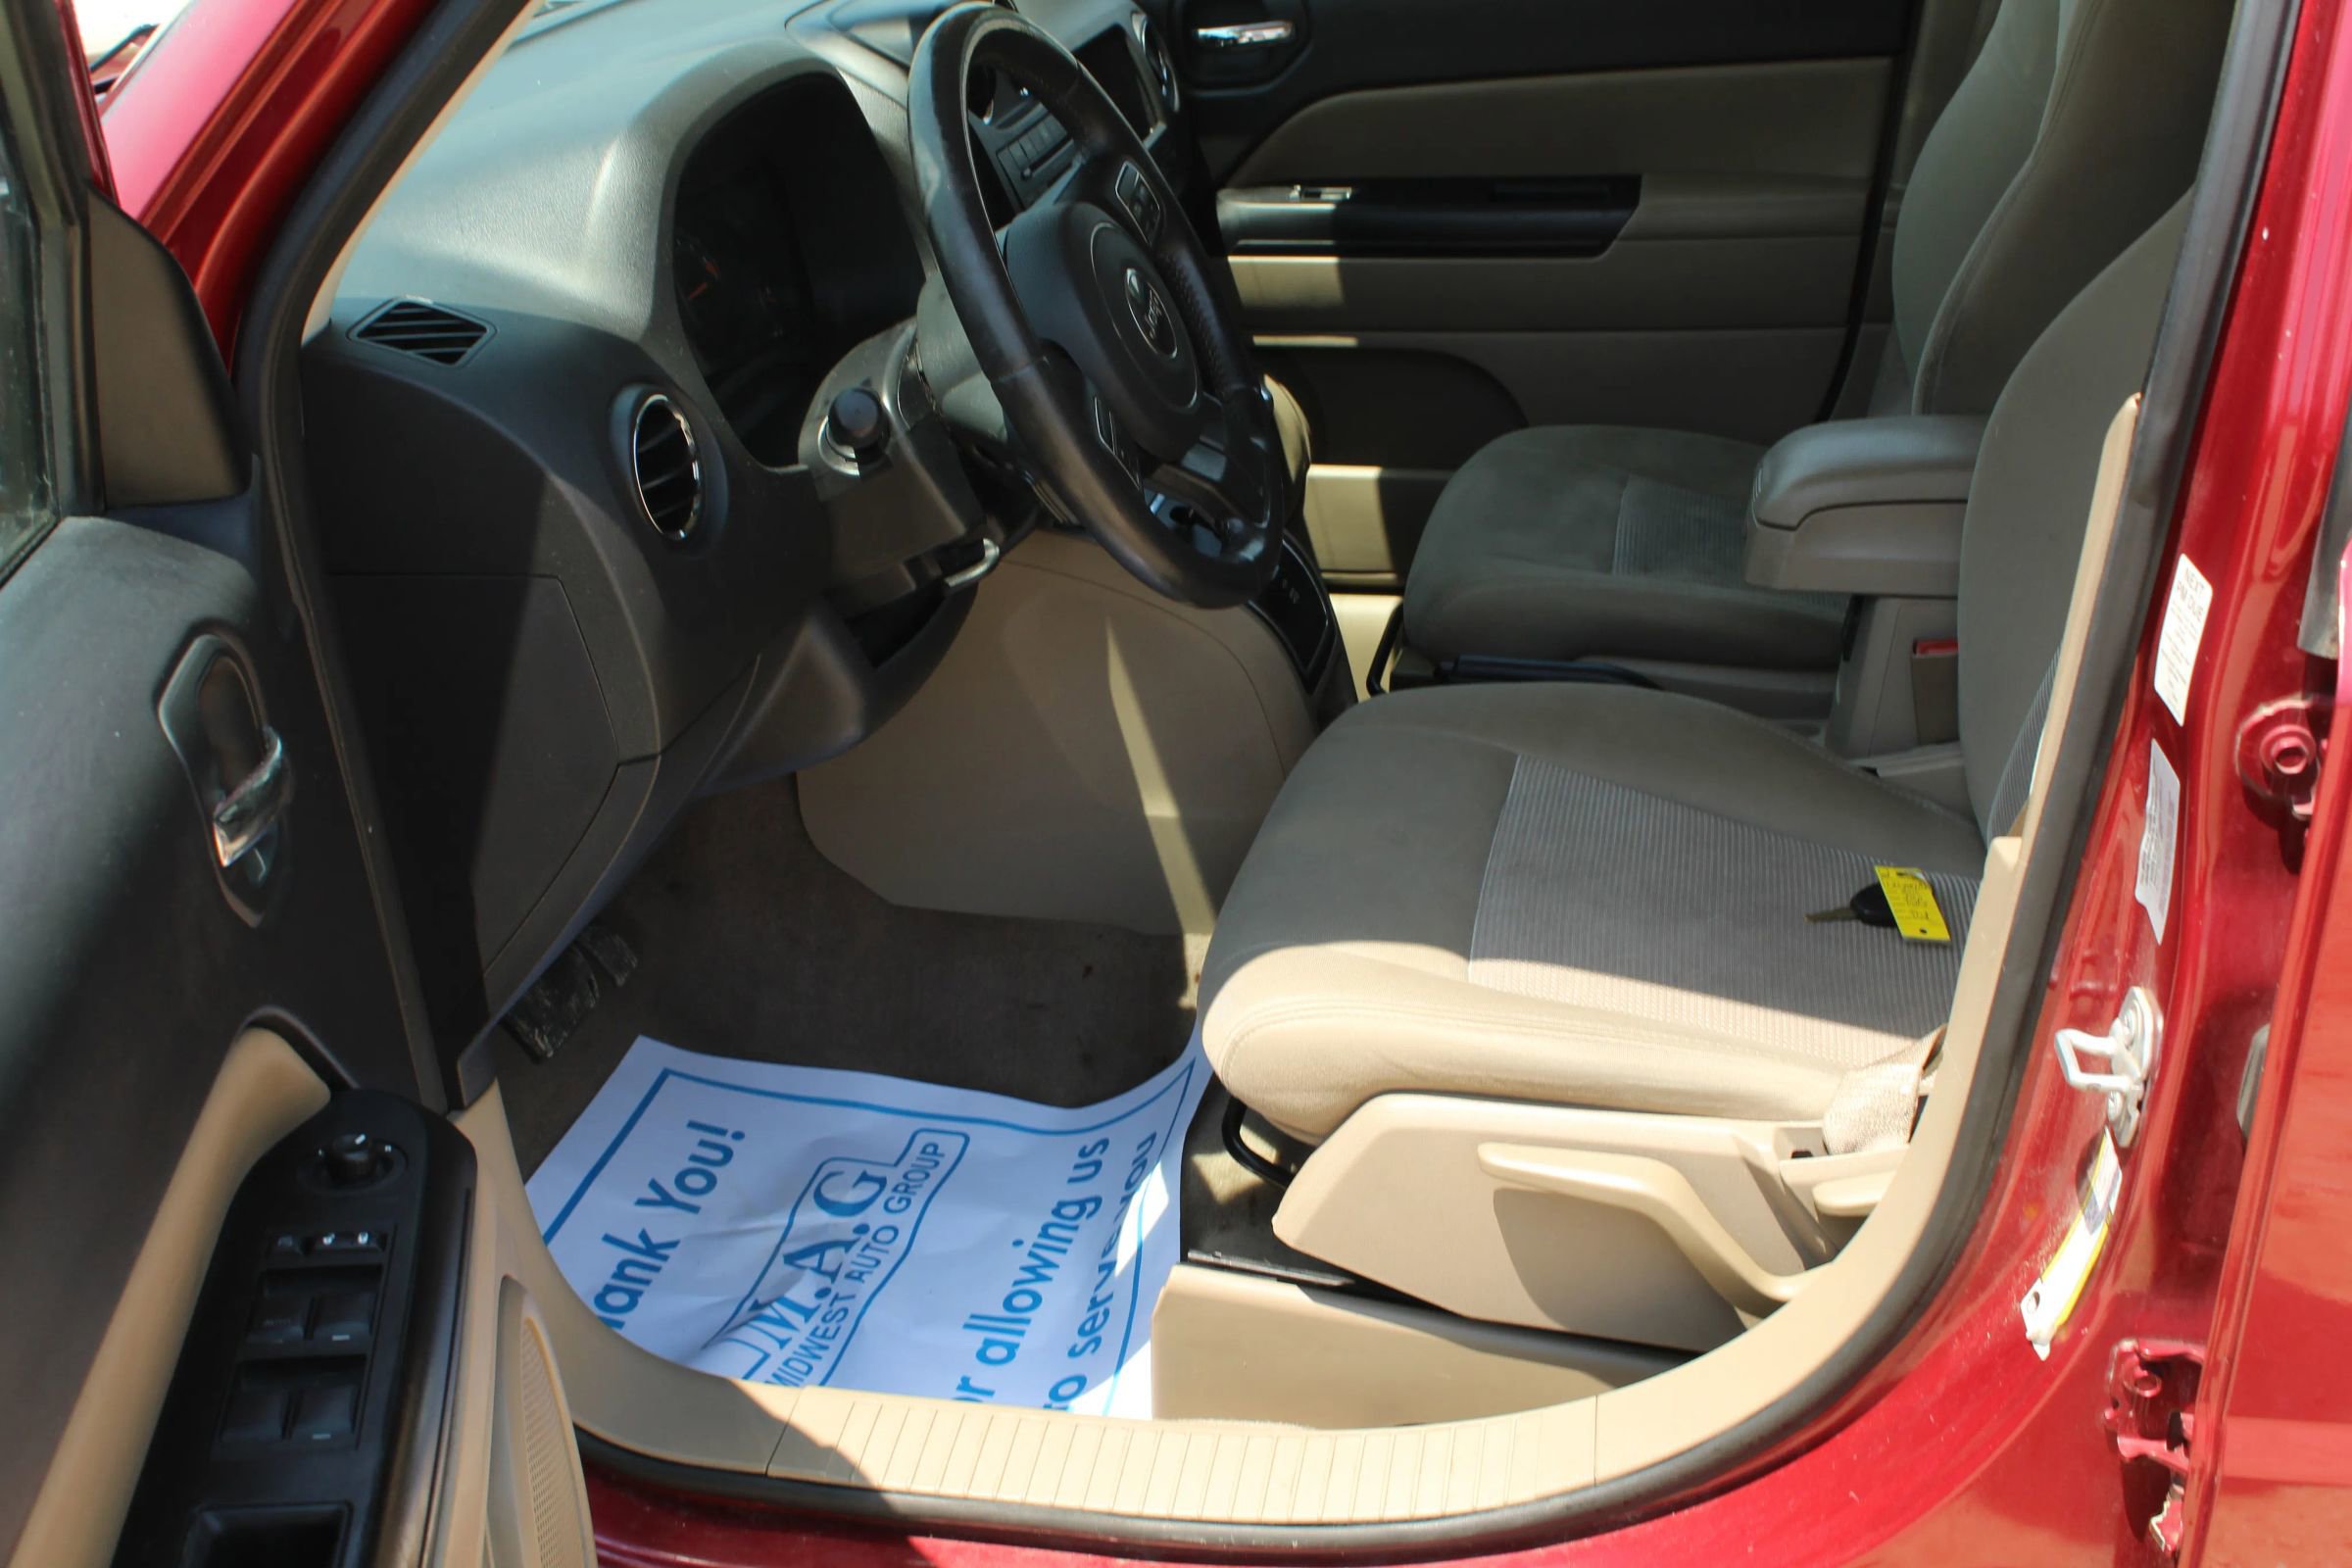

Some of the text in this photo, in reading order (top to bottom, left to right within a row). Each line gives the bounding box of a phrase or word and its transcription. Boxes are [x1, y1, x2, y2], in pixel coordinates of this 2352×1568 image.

[634, 1119, 745, 1214] You!
[845, 1225, 899, 1283] AUTO
[884, 1143, 946, 1214] GROUP
[962, 1196, 1103, 1365] allowing
[1067, 1137, 1110, 1185] us
